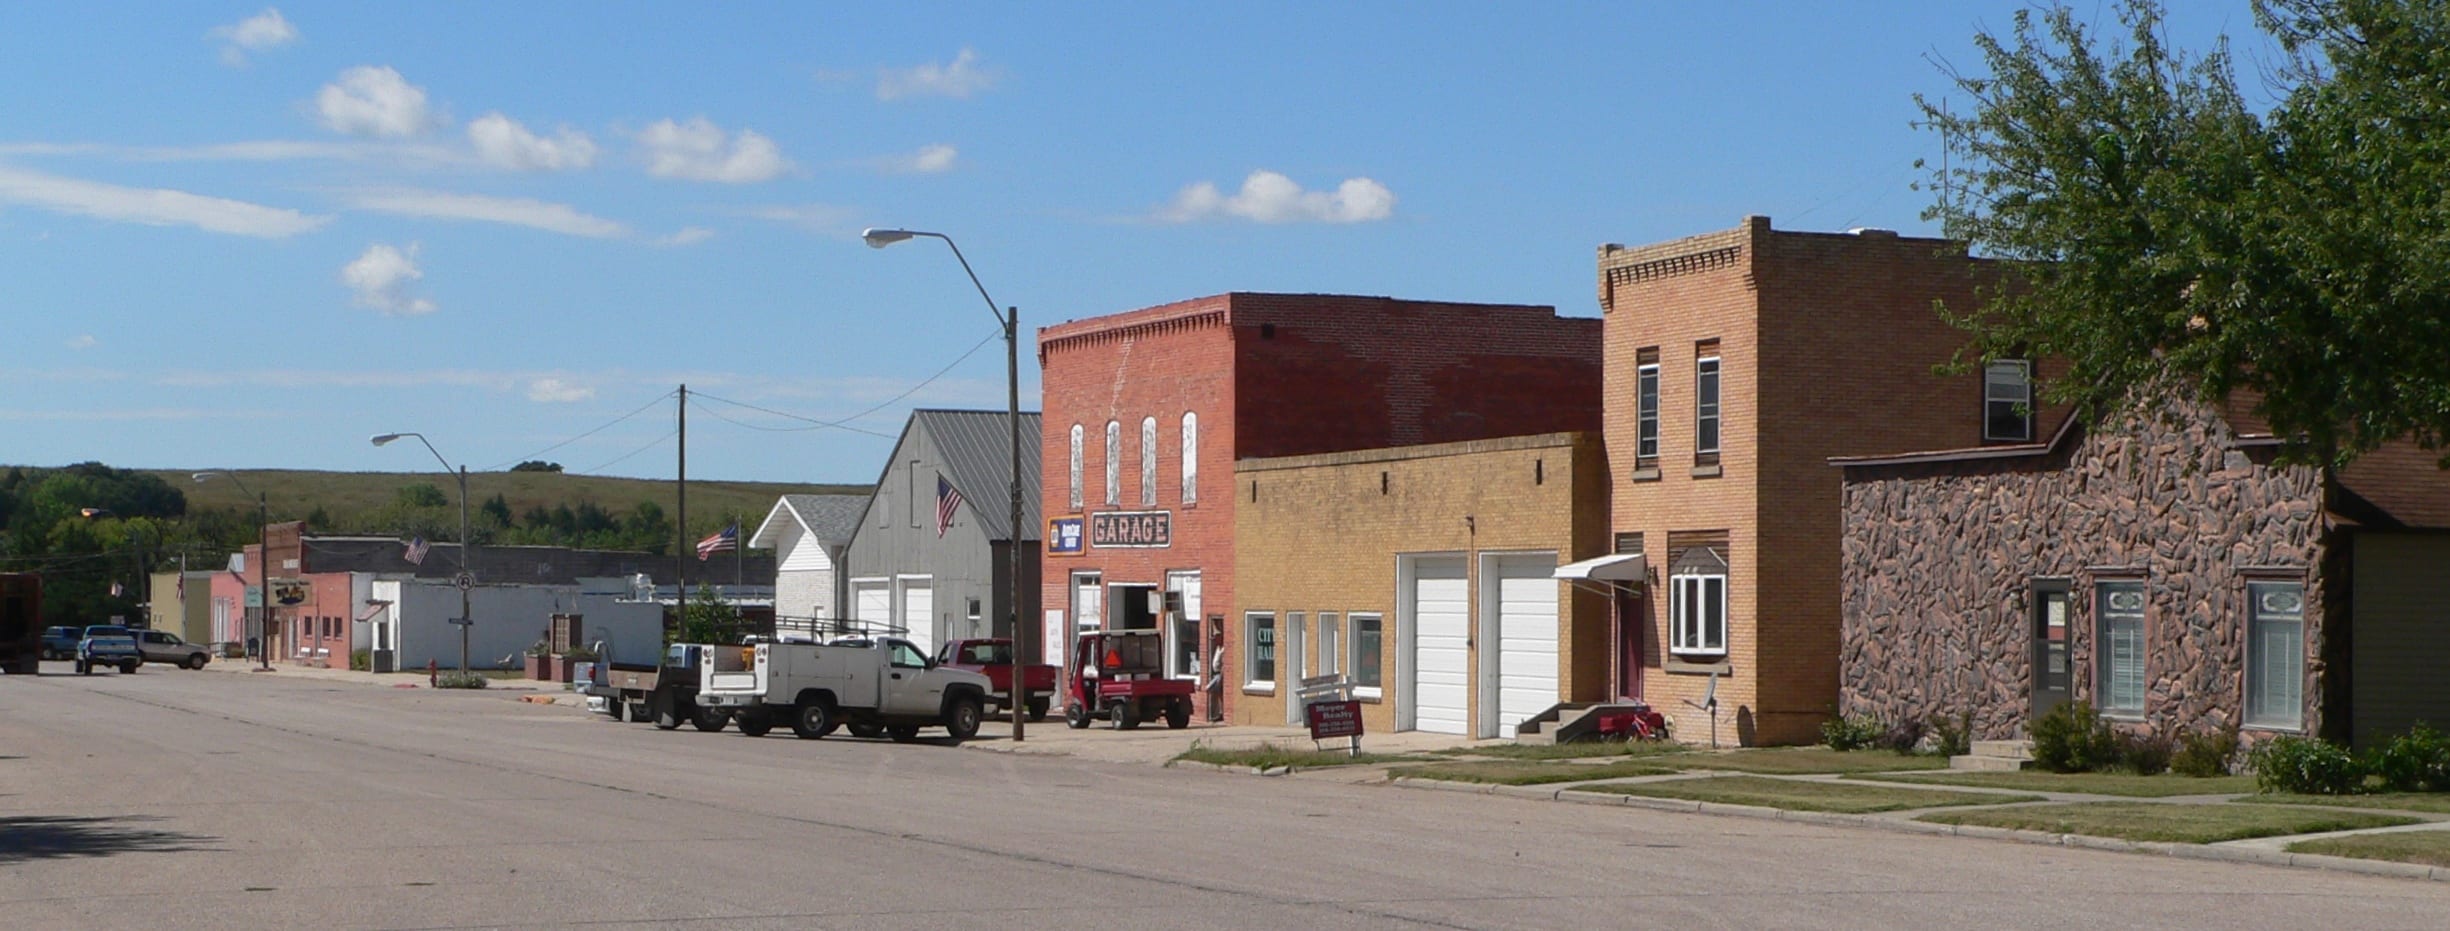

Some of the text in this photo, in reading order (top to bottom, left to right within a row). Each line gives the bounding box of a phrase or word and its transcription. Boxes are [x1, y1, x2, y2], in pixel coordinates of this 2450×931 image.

[1095, 517, 1167, 542] GARAGE
[1258, 628, 1276, 643] CITY
[1257, 646, 1276, 660] HAL
[1323, 711, 1354, 720] Realty
